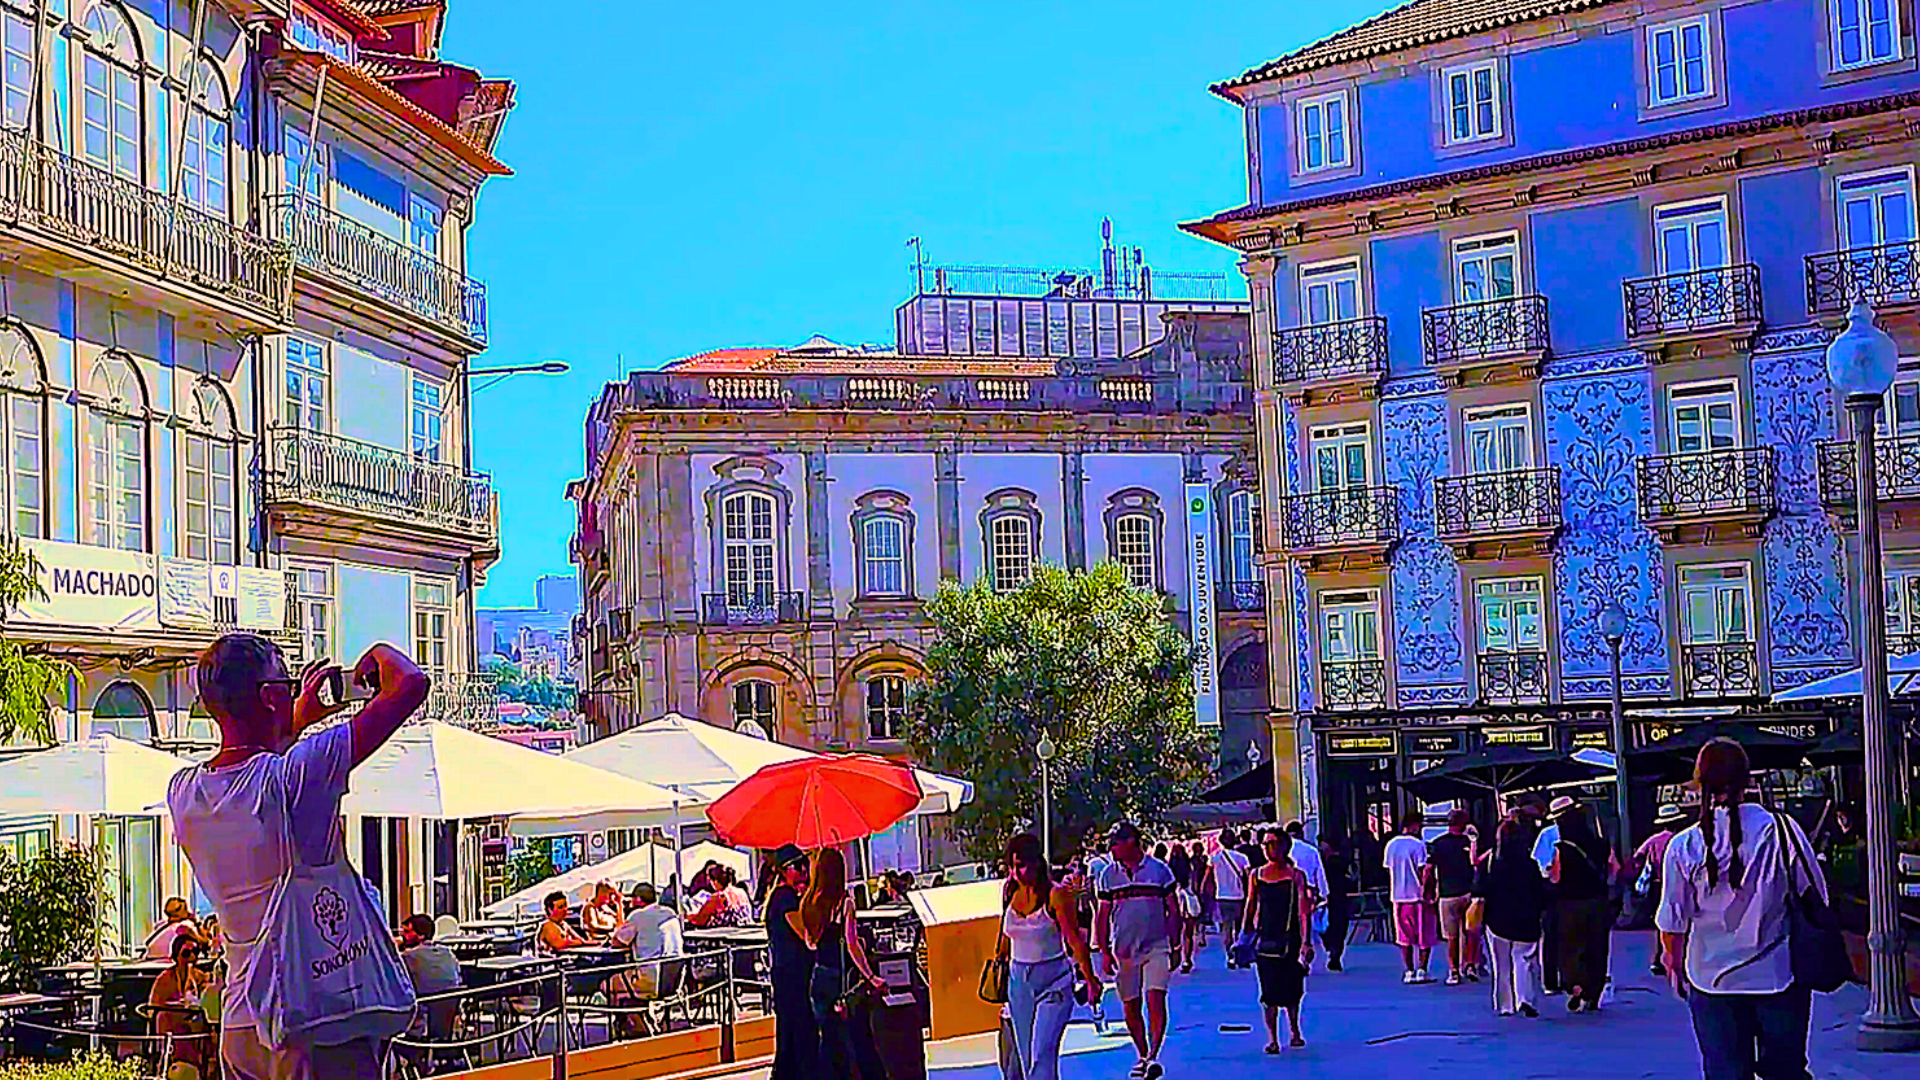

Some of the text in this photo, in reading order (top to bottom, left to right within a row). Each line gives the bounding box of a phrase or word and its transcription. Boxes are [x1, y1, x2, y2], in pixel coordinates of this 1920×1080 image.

[53, 567, 155, 598] MACHADO
[1195, 533, 1208, 606] JUVENTUDE
[1198, 606, 1209, 623] DA
